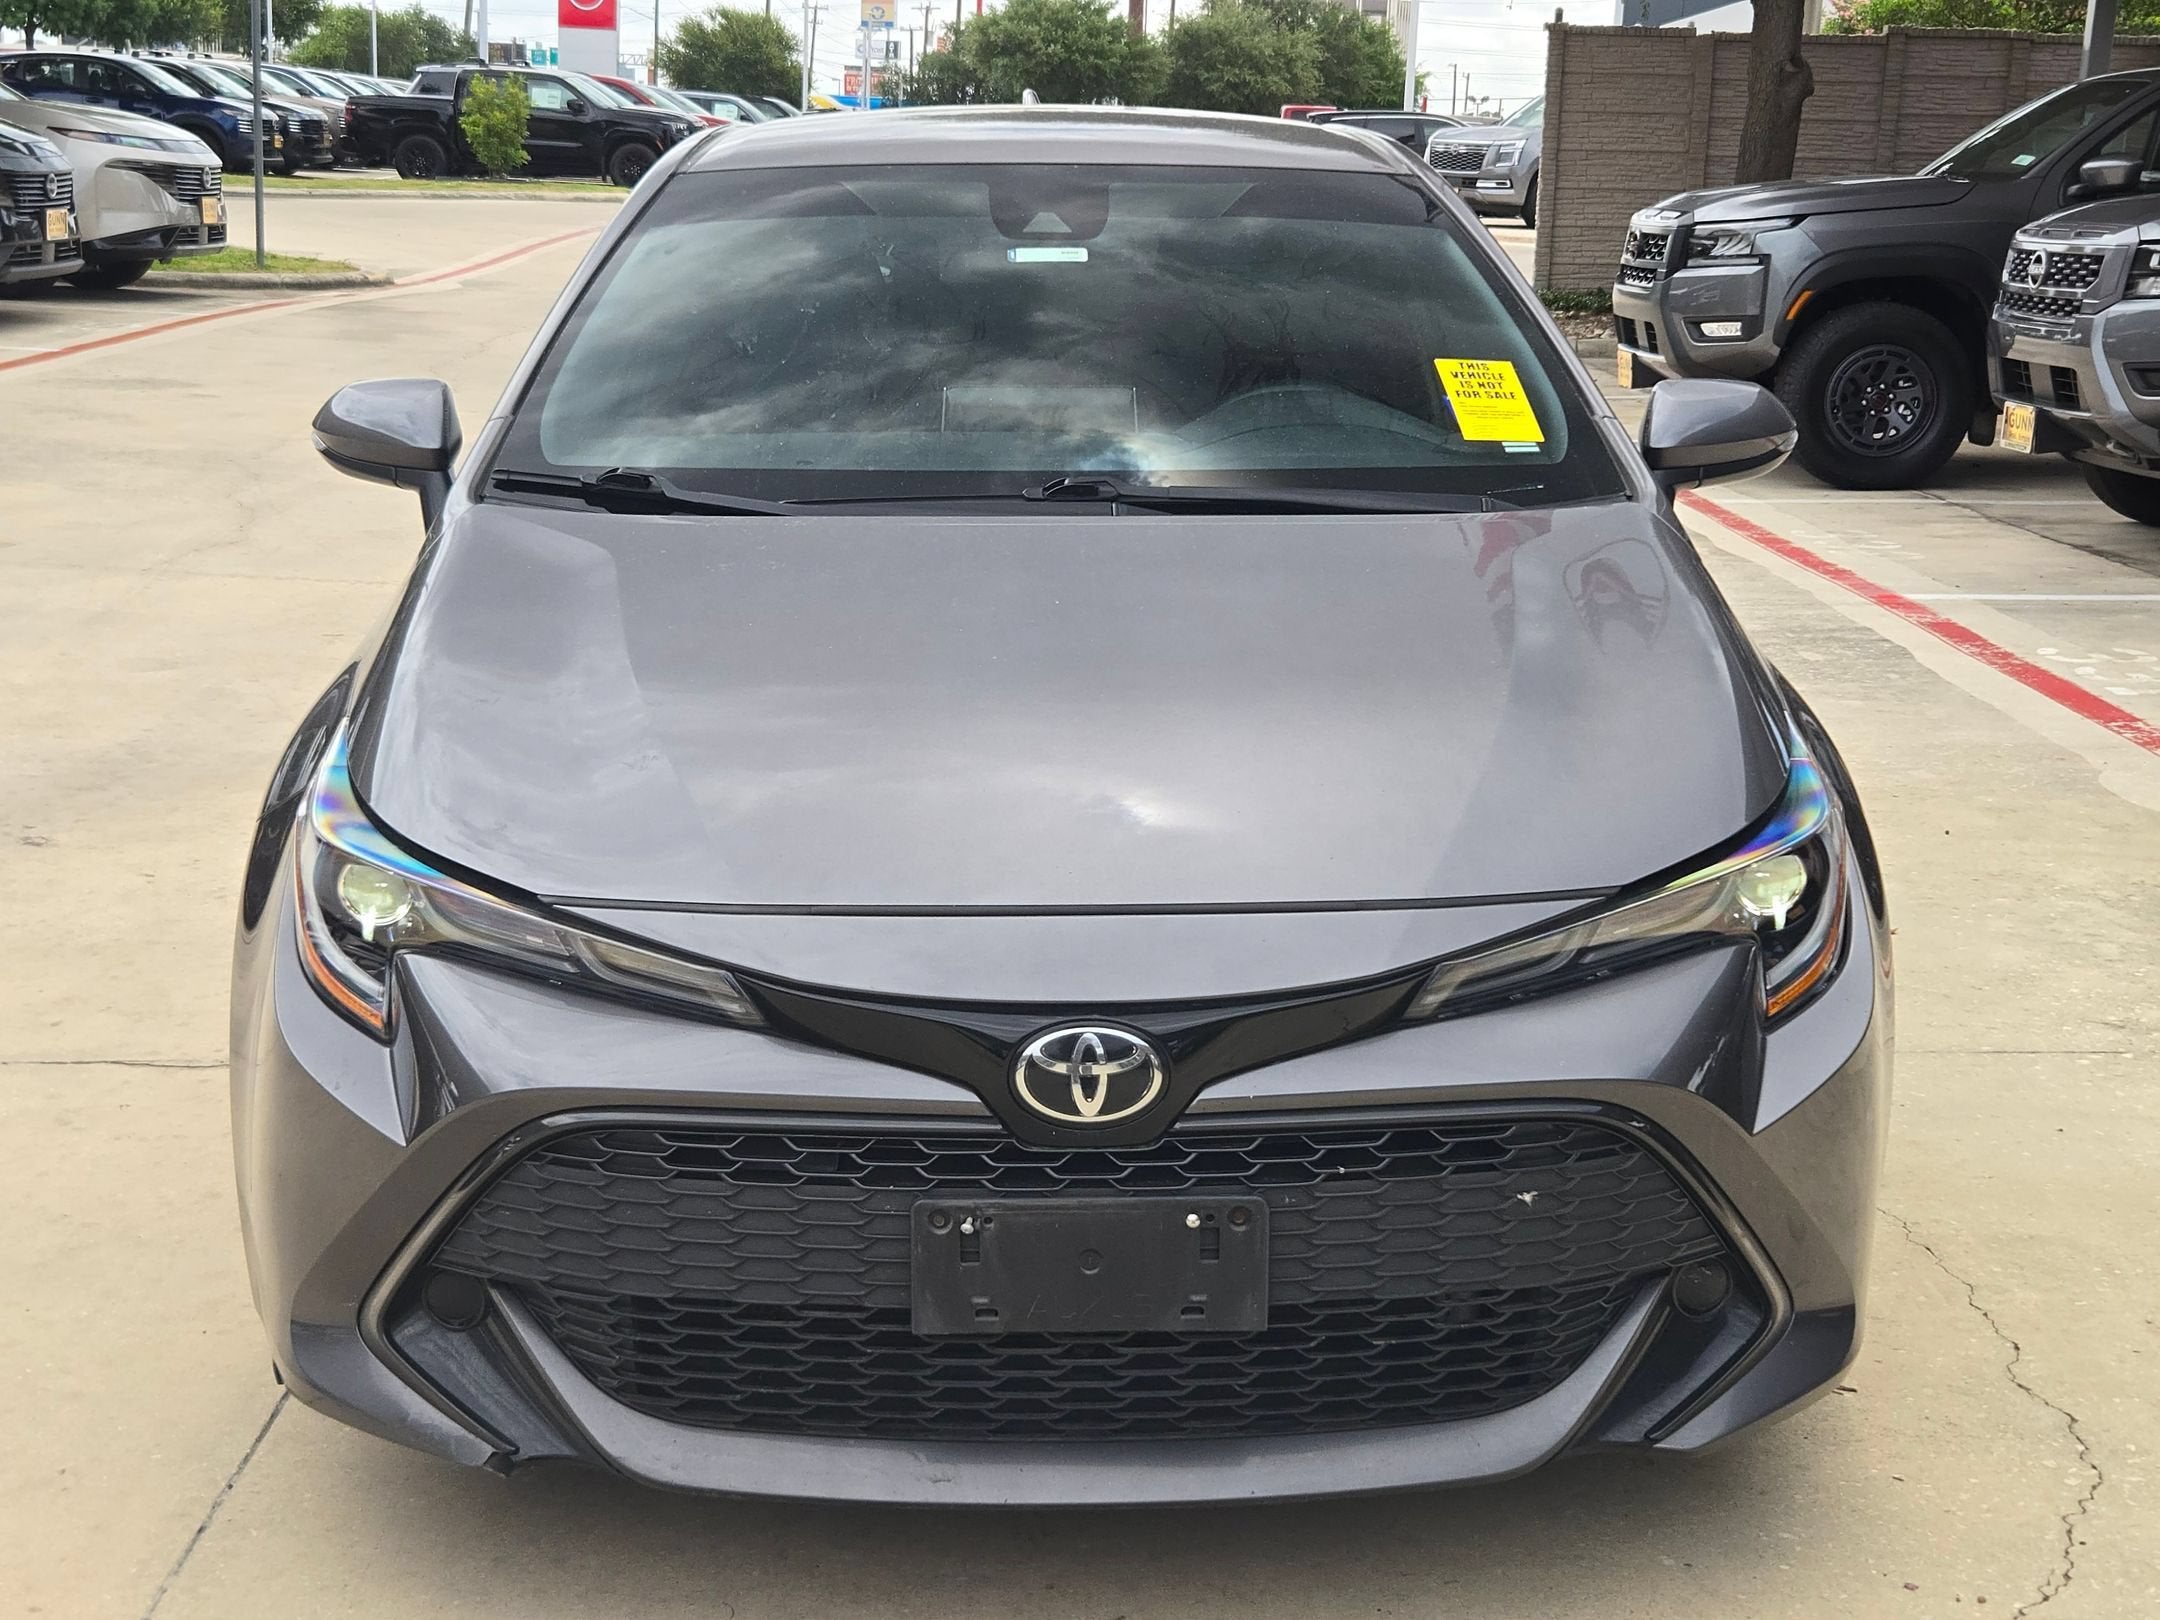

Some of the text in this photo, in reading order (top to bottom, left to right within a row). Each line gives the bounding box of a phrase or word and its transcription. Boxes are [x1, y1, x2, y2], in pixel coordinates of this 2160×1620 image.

[1459, 362, 1489, 371] THIS
[1450, 371, 1505, 381] VEHICLE
[1460, 381, 1503, 390] IS NOT
[1455, 390, 1516, 400] FOR SALE
[2009, 412, 2032, 432] GUNN
